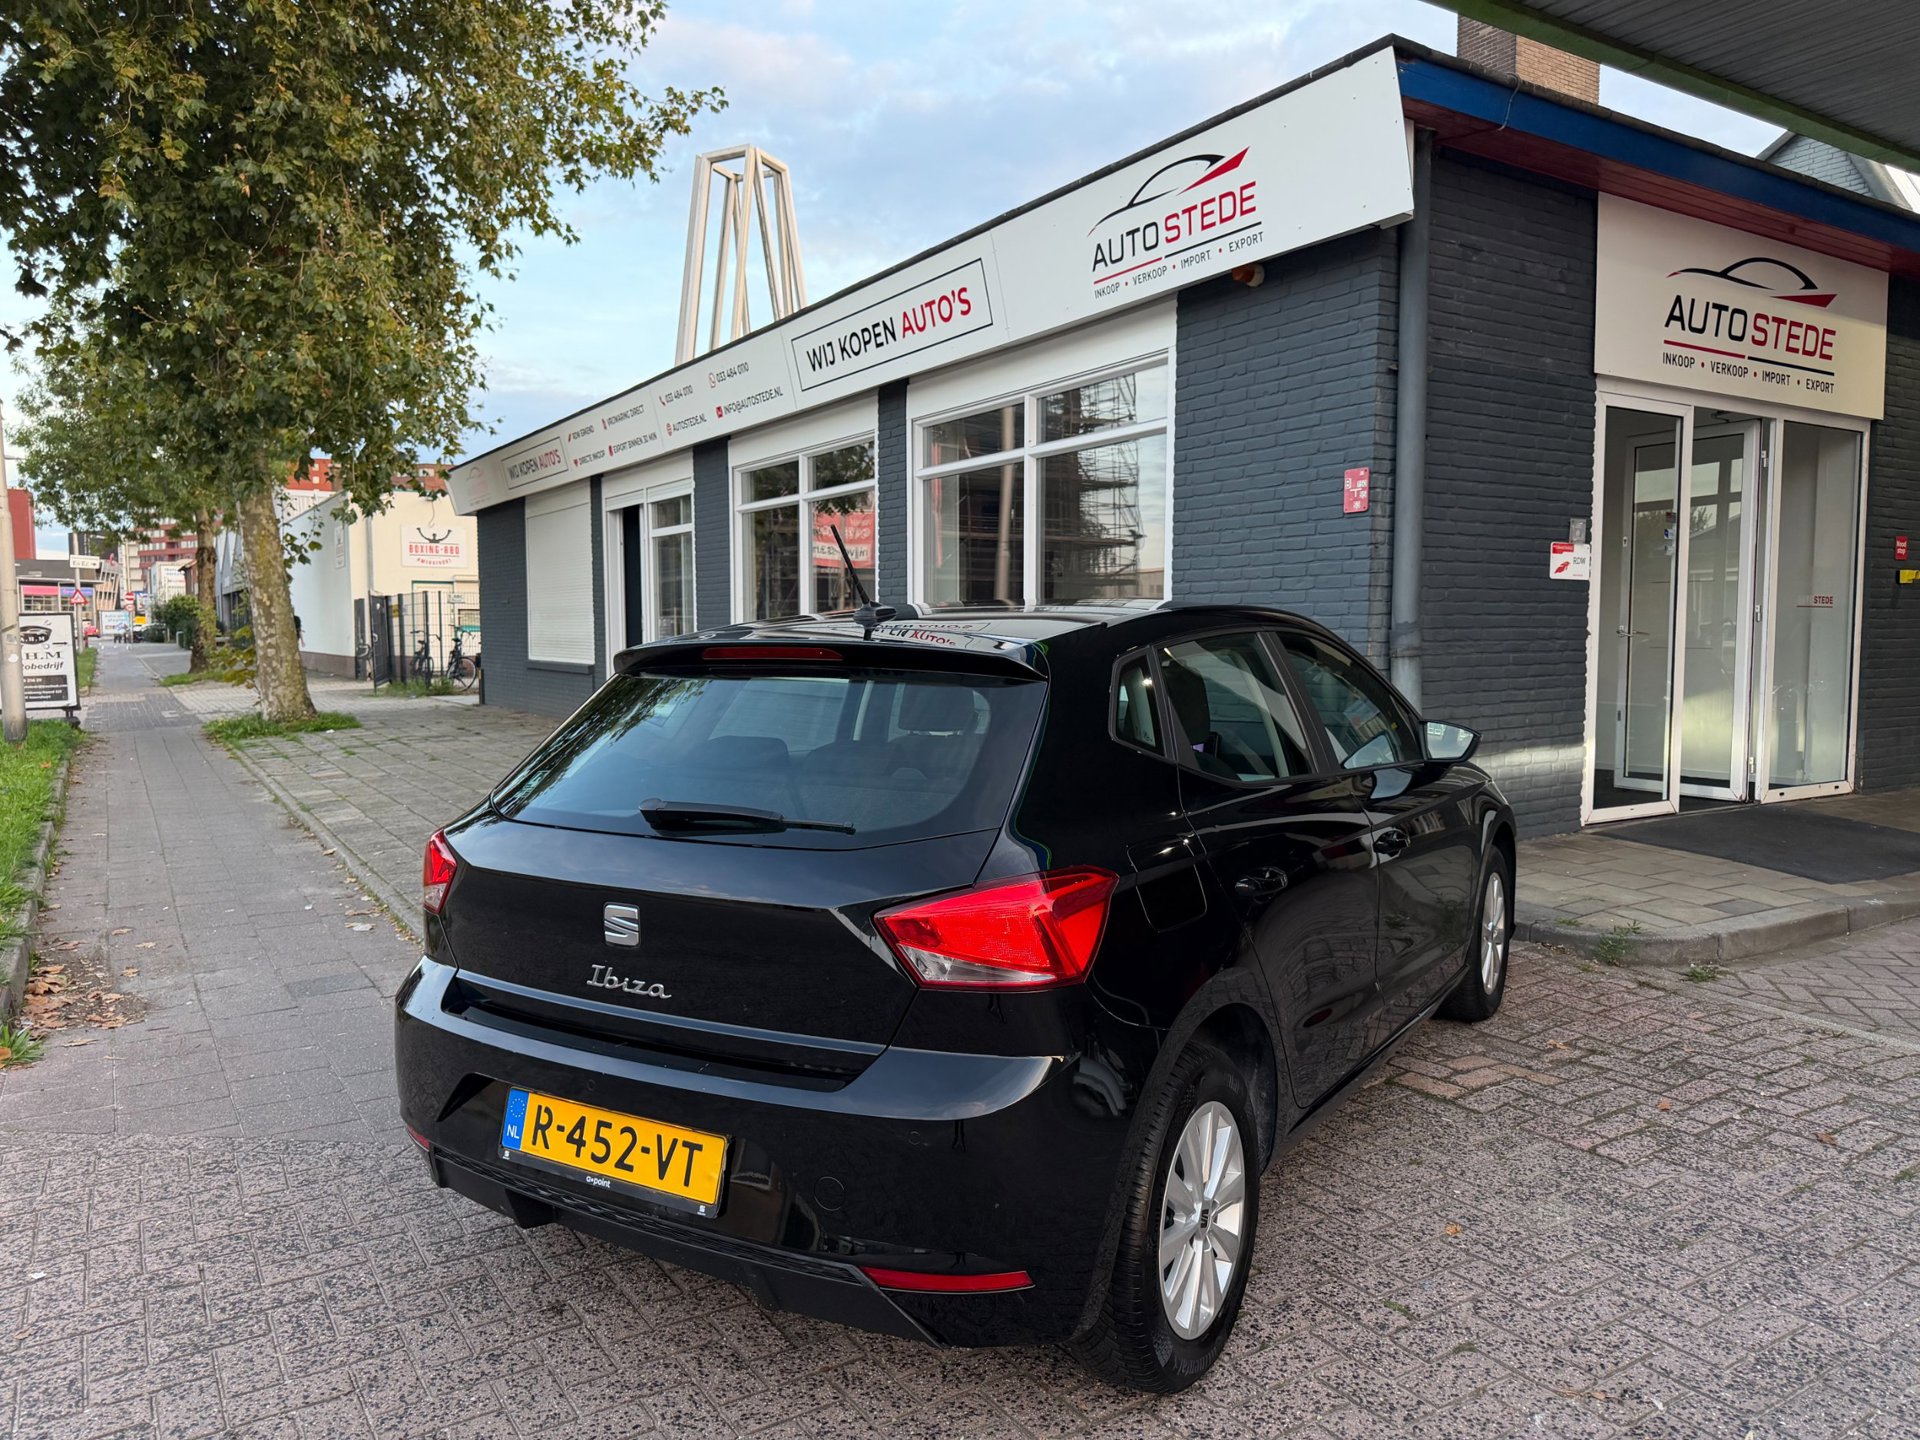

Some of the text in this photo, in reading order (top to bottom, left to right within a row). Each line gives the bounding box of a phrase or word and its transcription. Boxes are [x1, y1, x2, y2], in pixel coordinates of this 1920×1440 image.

[1094, 231, 1264, 299] INKOOP VERKOOP IMPORT EXPORT
[806, 286, 972, 372] WIJ KOPEN AUTO'S
[1662, 352, 1835, 394] INKOOP VERKOOP IMPORT EXPORT
[723, 386, 783, 415] INFO@AUTOSTEDE.NL
[672, 413, 707, 431] AUTOSTEDE.NL
[508, 449, 561, 480] WIJ KOPEN AUTO'S
[22, 661, 64, 670] obedrijf
[25, 651, 62, 660] H.M
[586, 964, 672, 999] Ibiza
[506, 1124, 520, 1140] NL
[531, 1104, 703, 1187] R-452-VT
